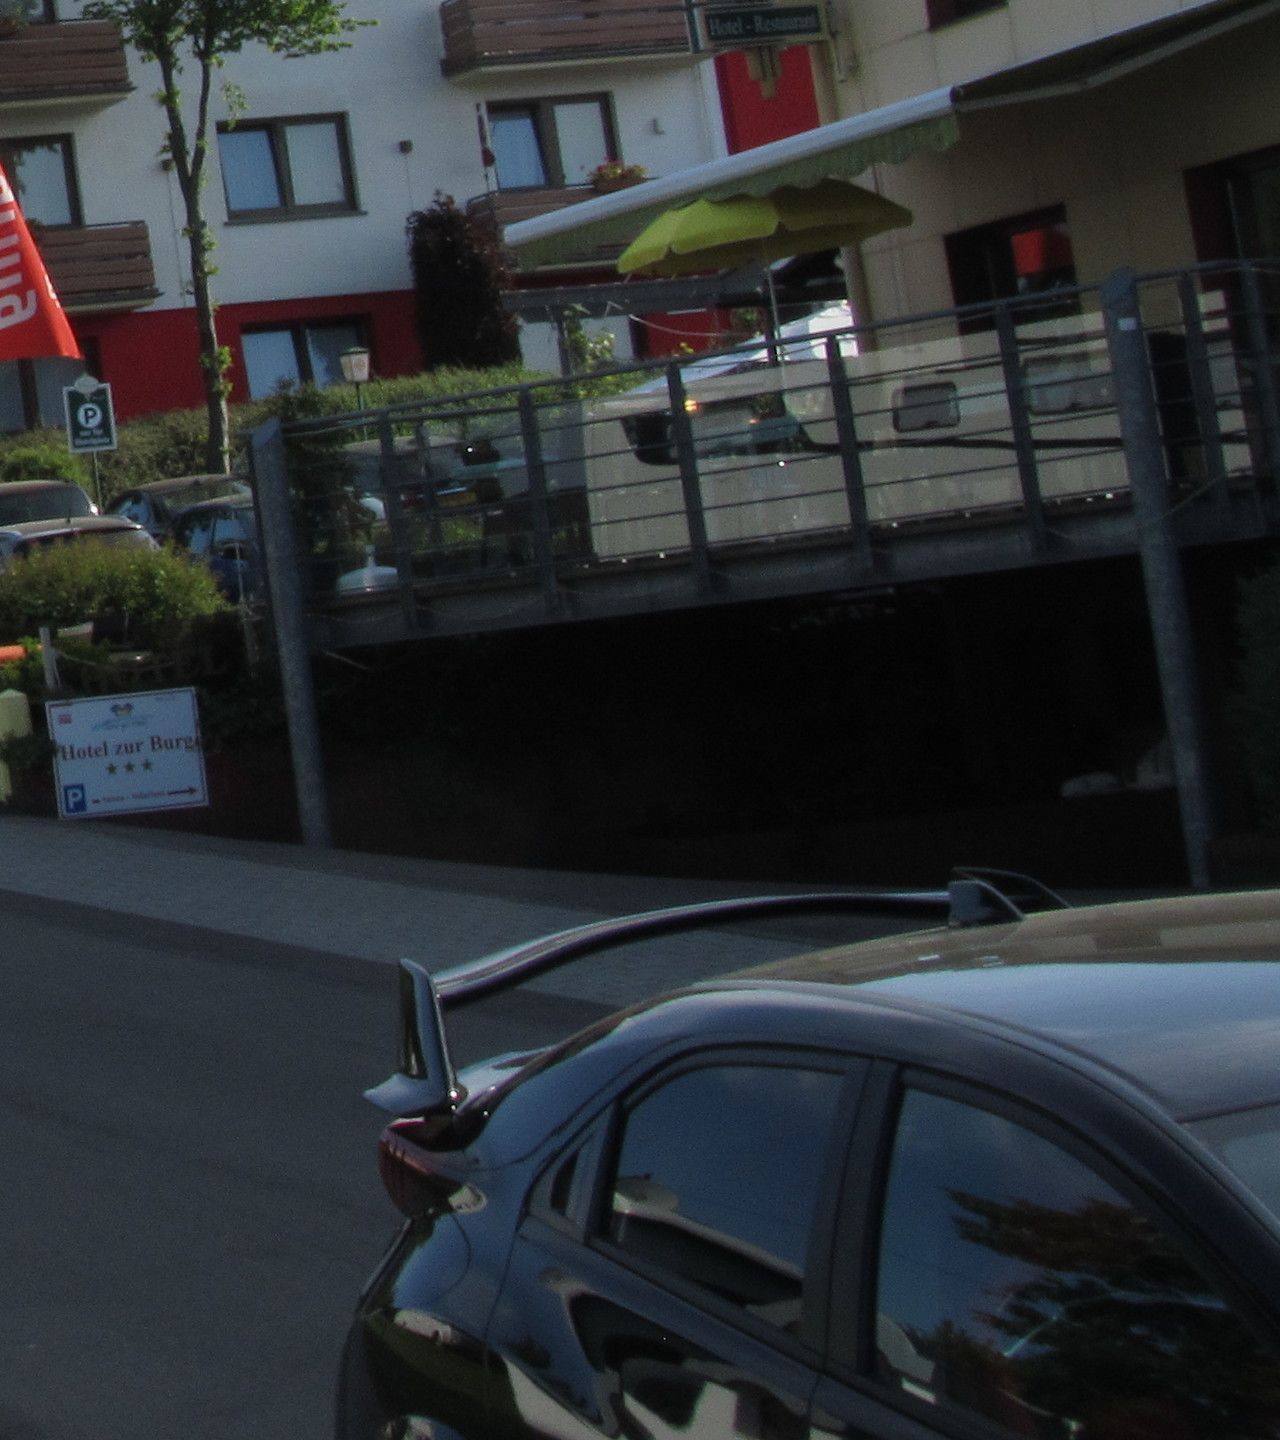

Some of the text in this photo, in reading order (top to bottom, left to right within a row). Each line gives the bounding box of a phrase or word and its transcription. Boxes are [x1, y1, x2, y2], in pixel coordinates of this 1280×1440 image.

[709, 15, 743, 36] Hotel
[84, 408, 97, 424] P
[61, 741, 108, 760] Hotel
[115, 742, 144, 756] zur
[66, 789, 81, 809] P
